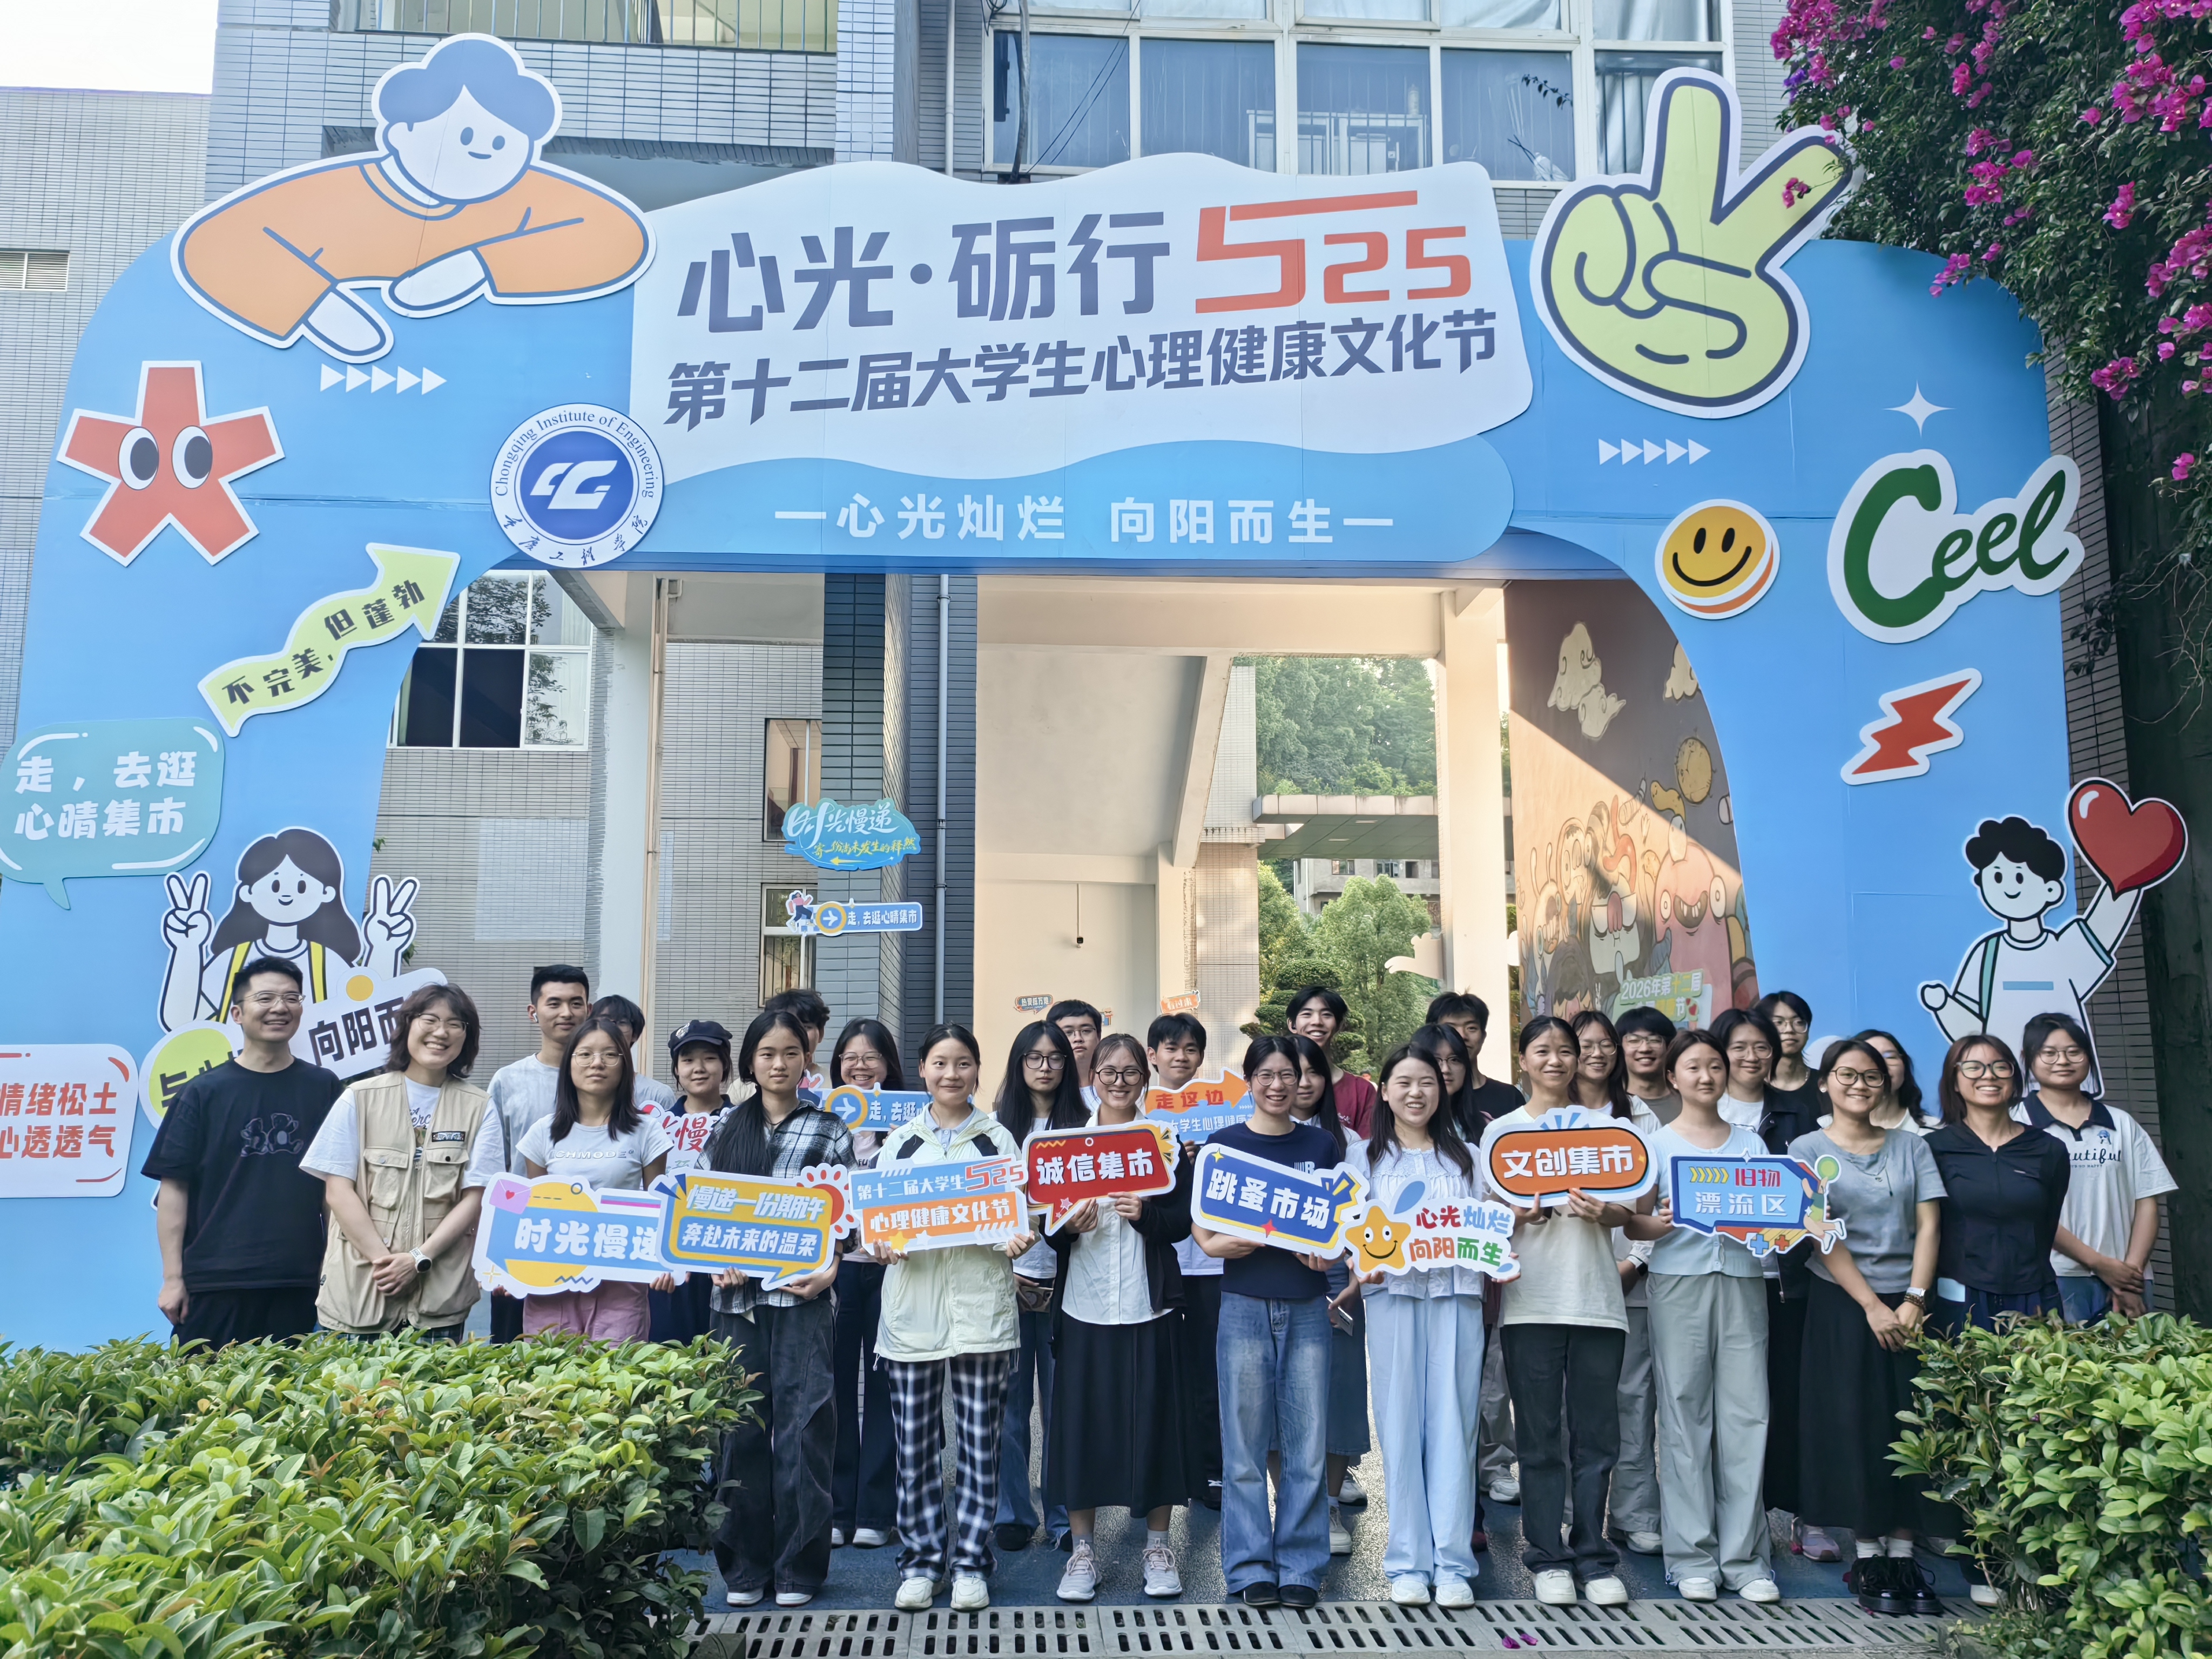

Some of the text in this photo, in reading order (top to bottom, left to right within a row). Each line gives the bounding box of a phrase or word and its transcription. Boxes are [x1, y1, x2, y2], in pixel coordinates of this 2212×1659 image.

[678, 212, 1170, 332] 心光·砺行
[664, 307, 1497, 429] 第十二届大学生心理健康文化节
[495, 410, 658, 498] Chongqing Institute of Engineering
[1844, 464, 2069, 628] Ceel
[222, 580, 424, 705] 不完美，但蓬勃
[14, 797, 186, 840] 心晴集市
[787, 802, 900, 849] 时光慢递
[848, 909, 916, 926] 走，去逛心晴集市
[308, 992, 413, 1066] 向阳而
[0, 1082, 117, 1116] 情绪松土
[1156, 1090, 1224, 1109] 走这边
[1036, 1148, 1154, 1186] 诚信集市
[1501, 1145, 1634, 1178] 文创集市
[2069, 1149, 2121, 1164] utiful
[1735, 1168, 1781, 1187] 旧物
[686, 1184, 825, 1222] 慢递一份期许
[871, 1198, 1010, 1232] 心理健康文化节
[1206, 1169, 1330, 1230] 跳蚤市场
[1695, 1192, 1788, 1217] 漂流区
[1416, 1205, 1511, 1235] 心光灿烂
[682, 1223, 817, 1257] 奔赴未来的温柔
[1409, 1237, 1503, 1267] 向阳而生
